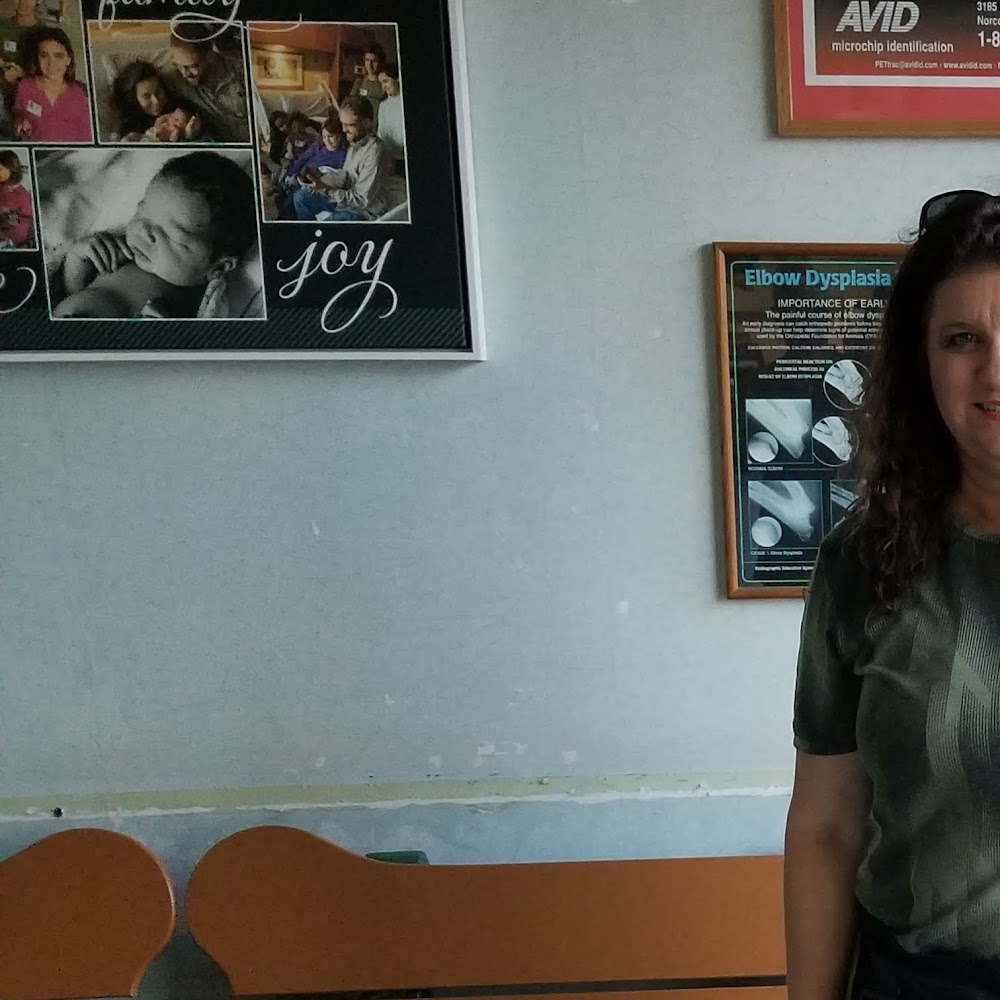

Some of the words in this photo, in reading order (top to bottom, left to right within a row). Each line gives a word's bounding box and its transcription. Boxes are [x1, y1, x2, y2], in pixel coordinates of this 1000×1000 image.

[976, 2, 997, 12] 3185
[835, 1, 920, 32] AVID
[832, 40, 884, 54] microchip
[887, 41, 954, 53] identification
[276, 229, 398, 334] joy
[744, 269, 801, 286] Elbow
[805, 268, 892, 291] Dysplasia
[777, 298, 841, 308] IMPORTANCE
[843, 299, 858, 308] OF
[765, 310, 780, 319] The
[781, 311, 807, 320] painful
[833, 311, 842, 319] of
[843, 311, 865, 319] elbow
